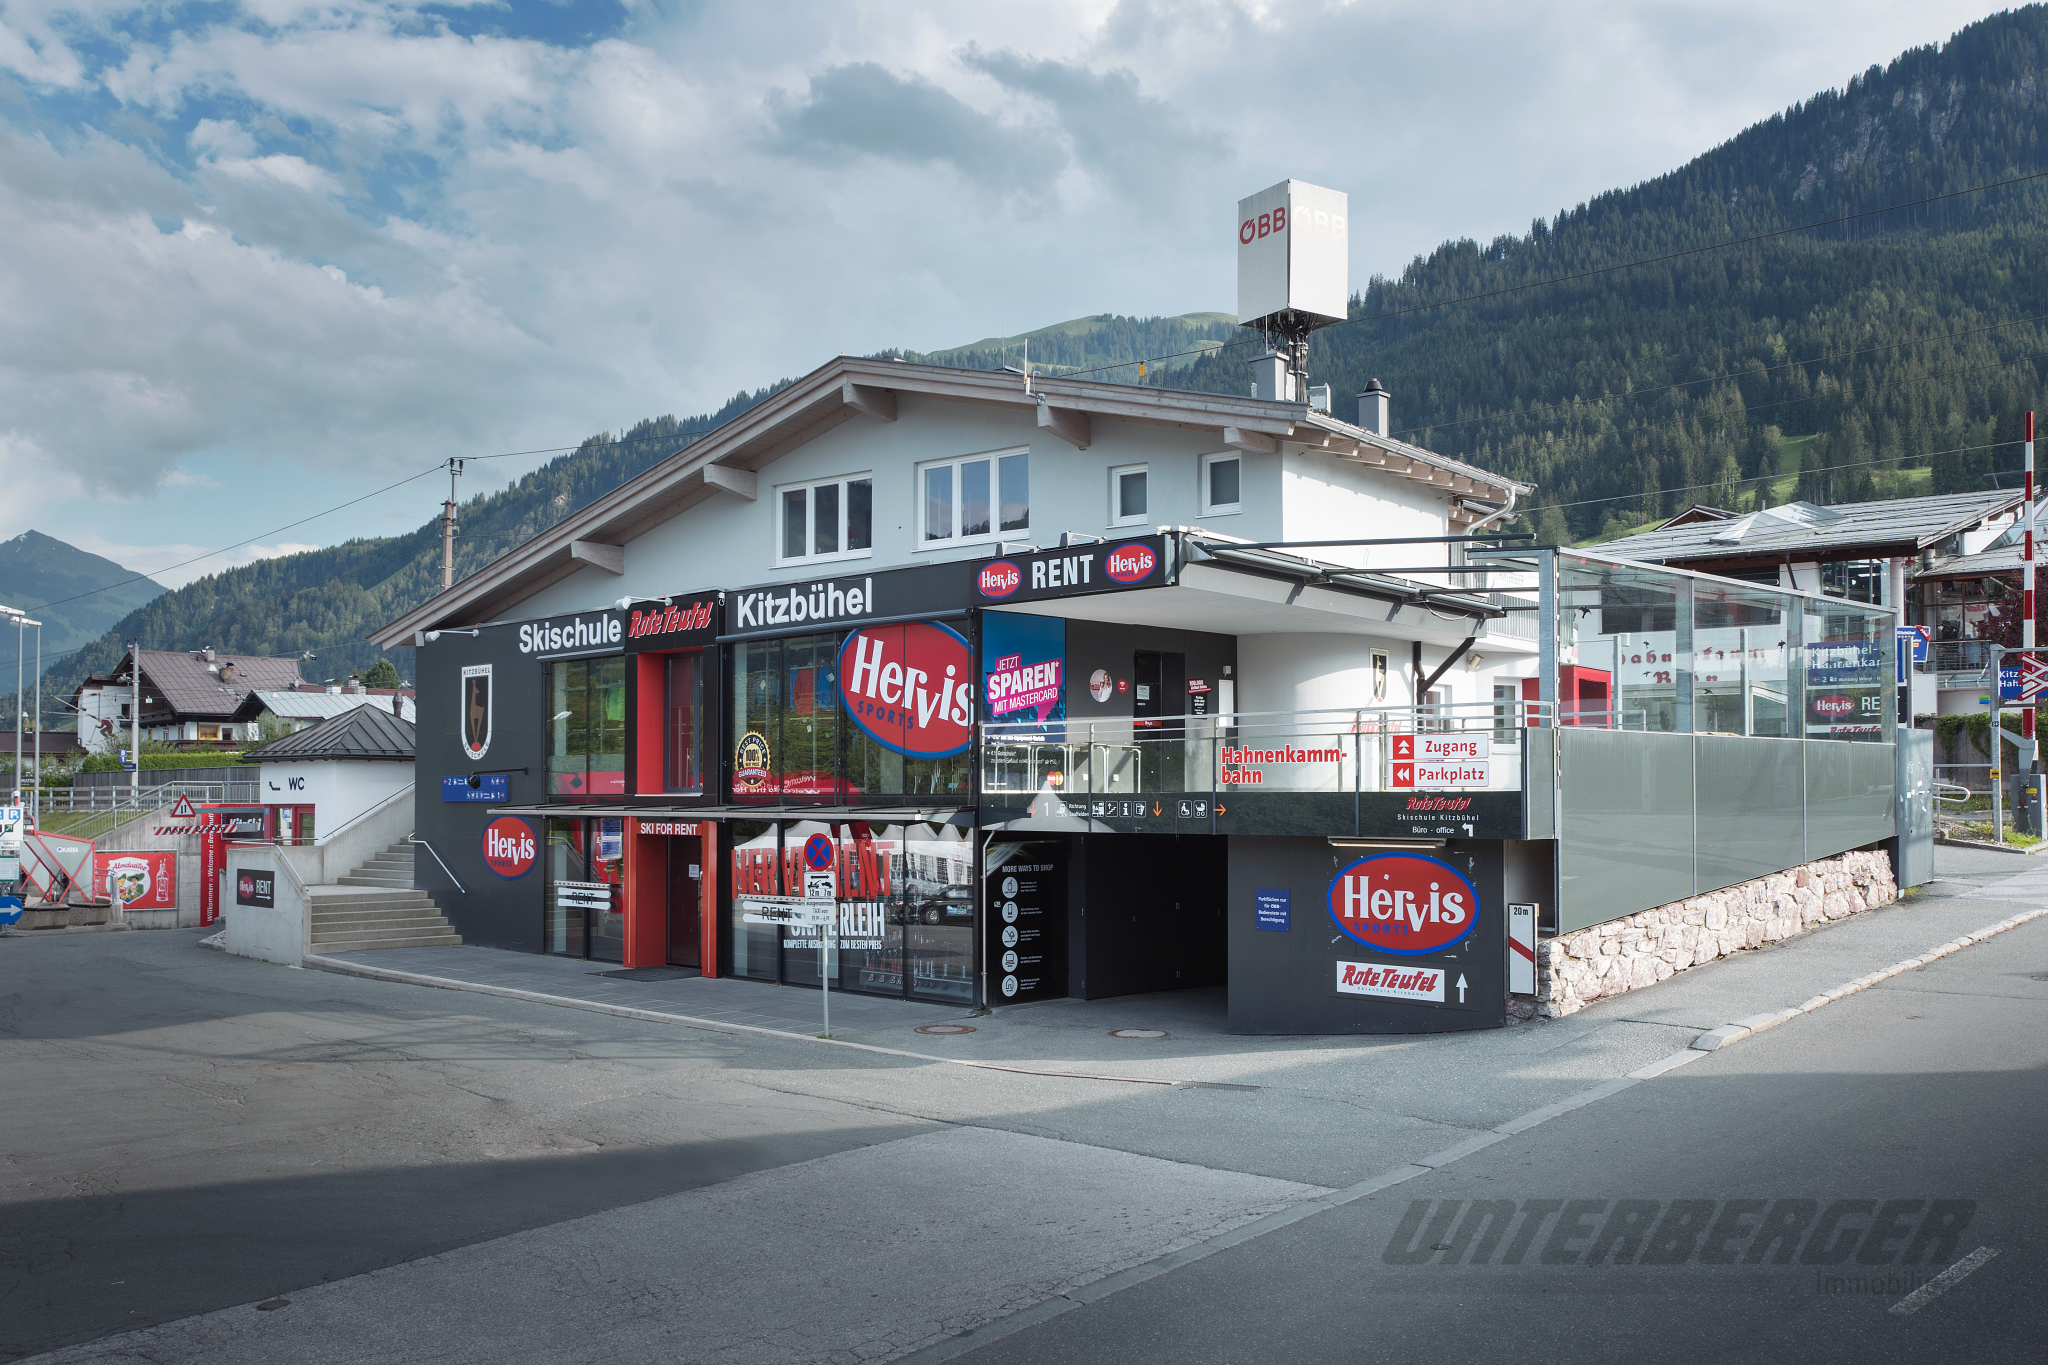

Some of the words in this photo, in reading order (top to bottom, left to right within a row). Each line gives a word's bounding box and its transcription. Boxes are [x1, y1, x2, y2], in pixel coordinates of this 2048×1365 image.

[1240, 206, 1286, 244] ÖBB
[1110, 552, 1153, 574] Hervis
[982, 569, 1018, 590] Hervis
[1032, 554, 1094, 590] RENT
[737, 577, 873, 628] Kitzbühel
[519, 613, 622, 653] Skischule
[463, 667, 491, 676] KITZBÜHEL
[996, 655, 1019, 672] JETZT
[850, 635, 974, 728] Hervis
[994, 699, 1008, 714] MIT
[1009, 687, 1058, 710] MASTERCARD
[1816, 700, 1852, 713] Hervis
[857, 700, 914, 730] SPORTS
[740, 738, 751, 755] BEST
[753, 737, 766, 755] PRICE
[1221, 744, 1348, 764] Hahnenkamm-
[1425, 740, 1477, 756] Zugang
[746, 749, 760, 762] 100%
[288, 776, 305, 790] WC
[1221, 765, 1263, 784] bahn
[1419, 767, 1485, 784] Parkplatz
[1043, 802, 1049, 816] 1
[1068, 803, 1087, 811] Richtung
[1397, 813, 1436, 821] Skischule
[1440, 813, 1479, 821] Kitzbühel
[640, 823, 655, 835] SKI
[656, 823, 673, 835] FOR
[675, 824, 698, 835] RENT
[1412, 826, 1428, 834] Büro
[1436, 826, 1455, 834] office
[488, 829, 535, 866] Hervis
[1002, 865, 1017, 873] MORE
[1018, 864, 1032, 872] WAYS
[256, 879, 272, 895] RENT
[571, 891, 595, 906] RENT
[1344, 875, 1466, 932] Hervis
[761, 906, 793, 922] RENT
[1354, 922, 1409, 935] SPORTS
[839, 939, 850, 949] ZUM
[851, 940, 868, 950] BESTEN
